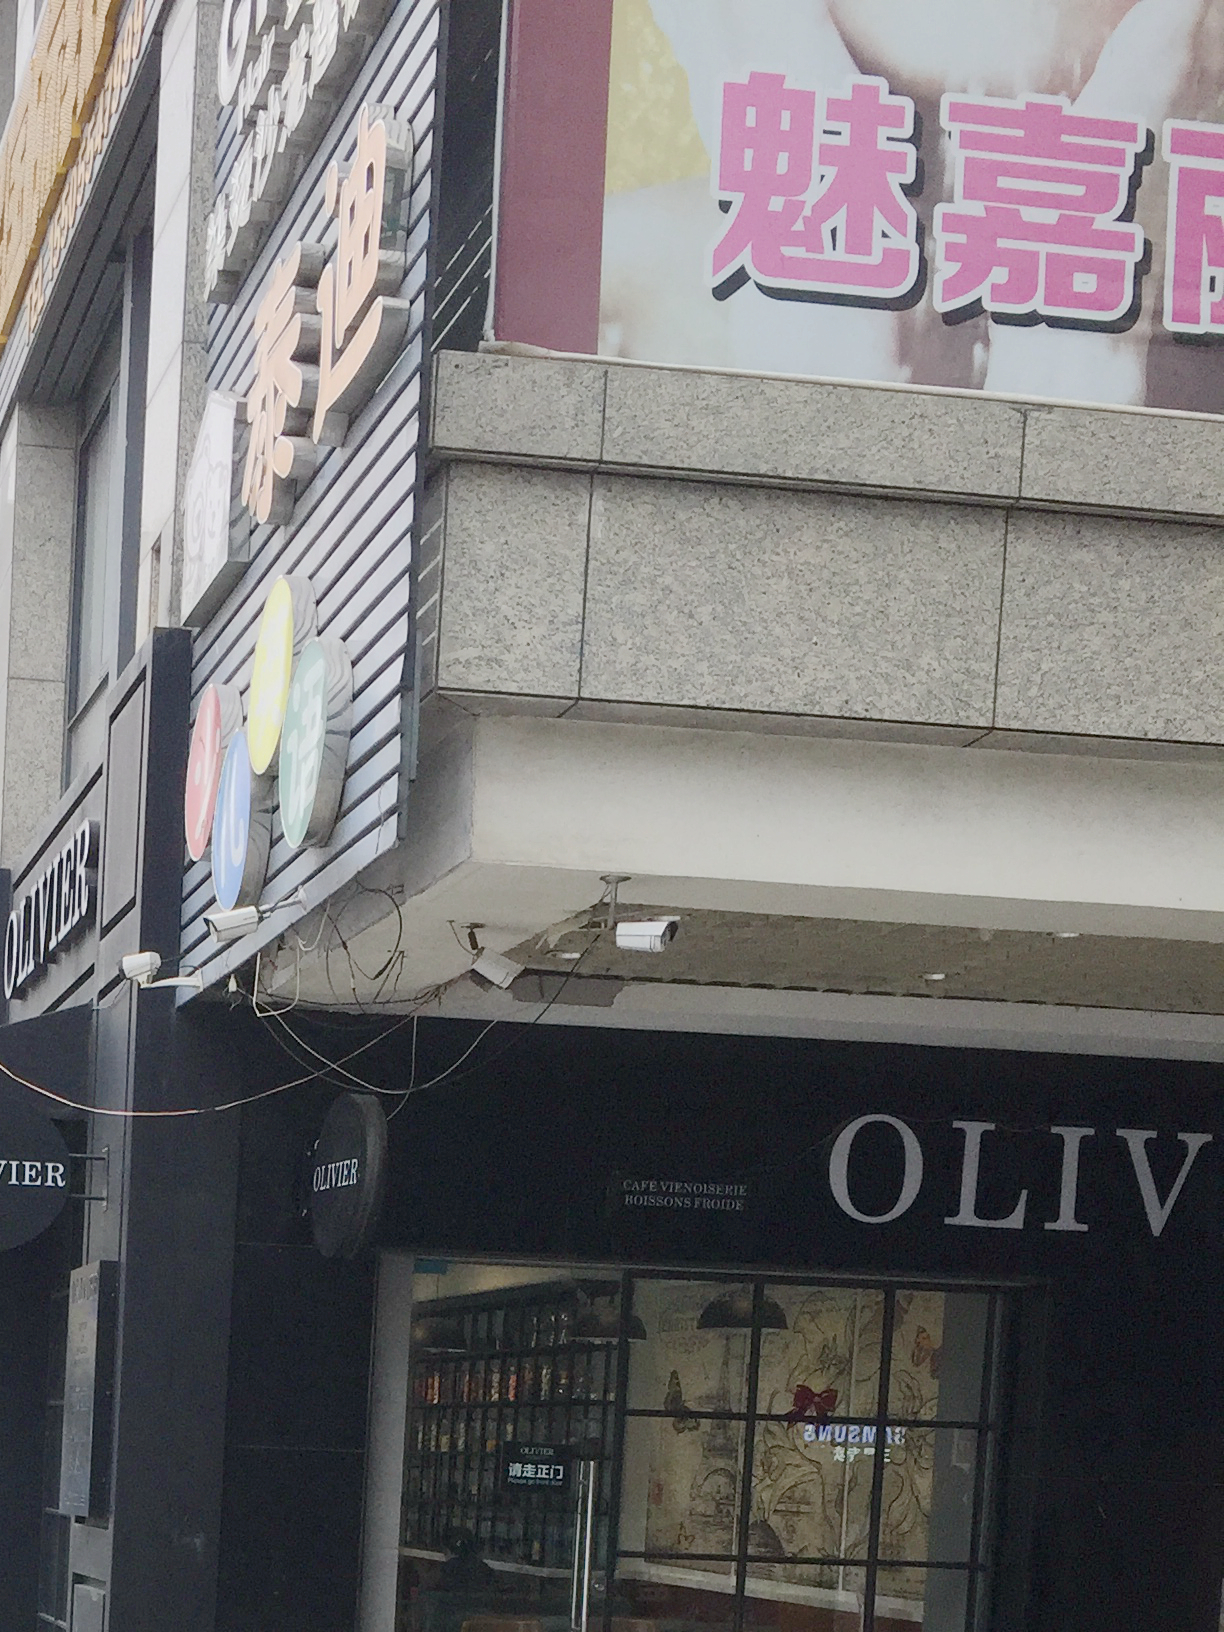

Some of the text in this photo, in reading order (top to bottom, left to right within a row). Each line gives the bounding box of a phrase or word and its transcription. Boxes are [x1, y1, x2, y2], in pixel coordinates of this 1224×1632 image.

[237, 25, 275, 135] Hair
[241, 102, 386, 525] 泰迪
[4, 817, 90, 1000] OLIVIER
[313, 1158, 359, 1192] OLIVIER
[828, 1113, 1214, 1239] OLIV
[508, 1463, 564, 1480] 请走正门
